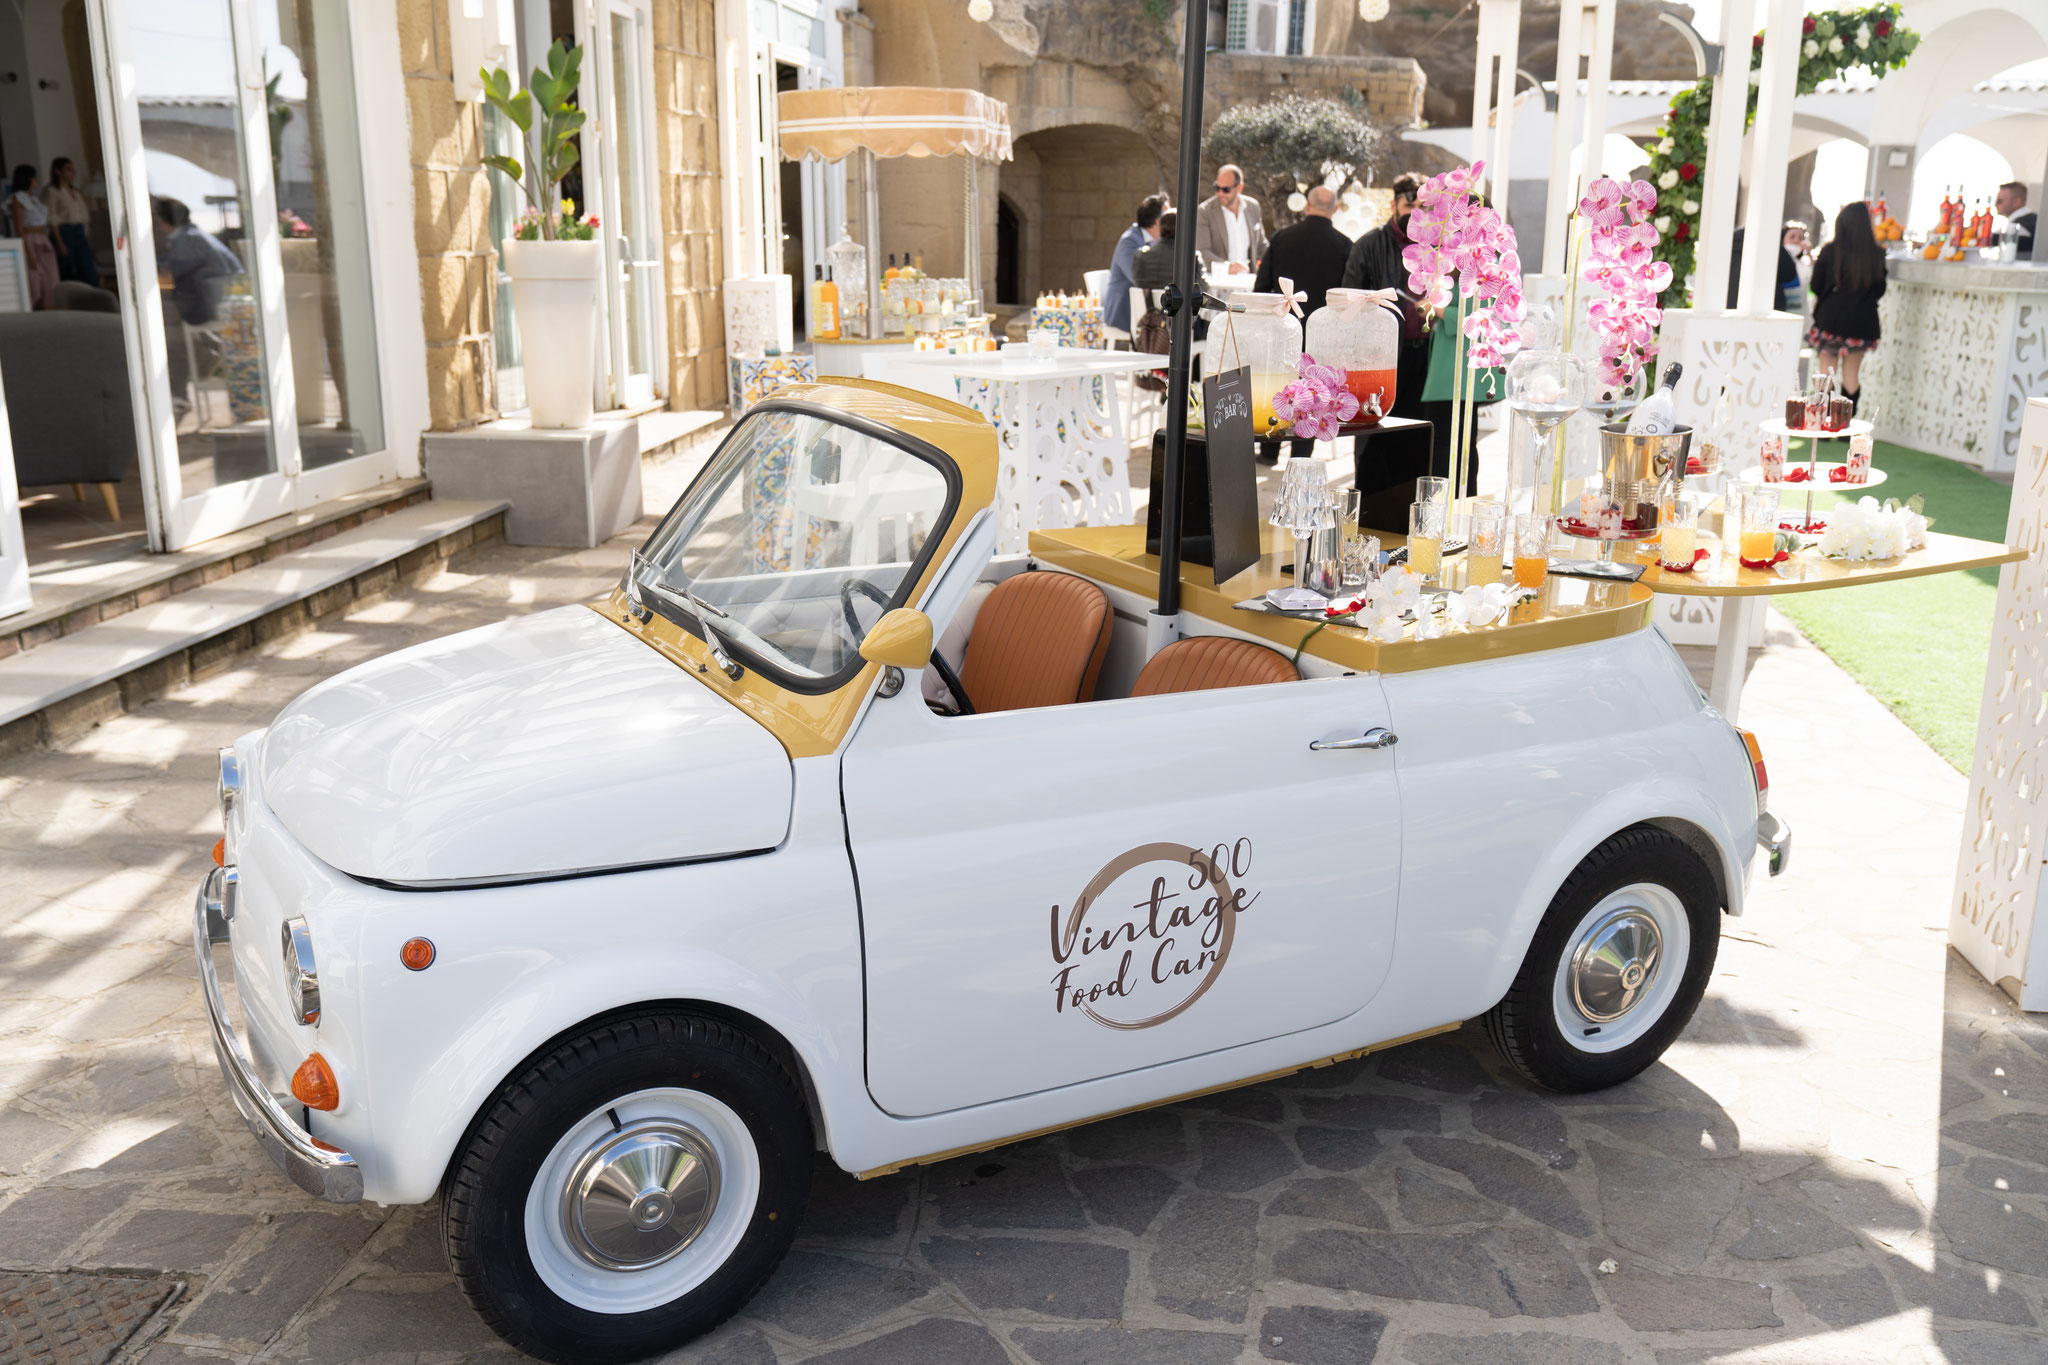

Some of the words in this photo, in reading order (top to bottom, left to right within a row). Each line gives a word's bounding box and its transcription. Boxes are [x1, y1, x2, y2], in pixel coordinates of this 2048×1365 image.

[1224, 403, 1237, 420] BAR
[1187, 837, 1252, 890] 500
[1050, 876, 1261, 964] Vintage
[1050, 949, 1137, 1014] Food
